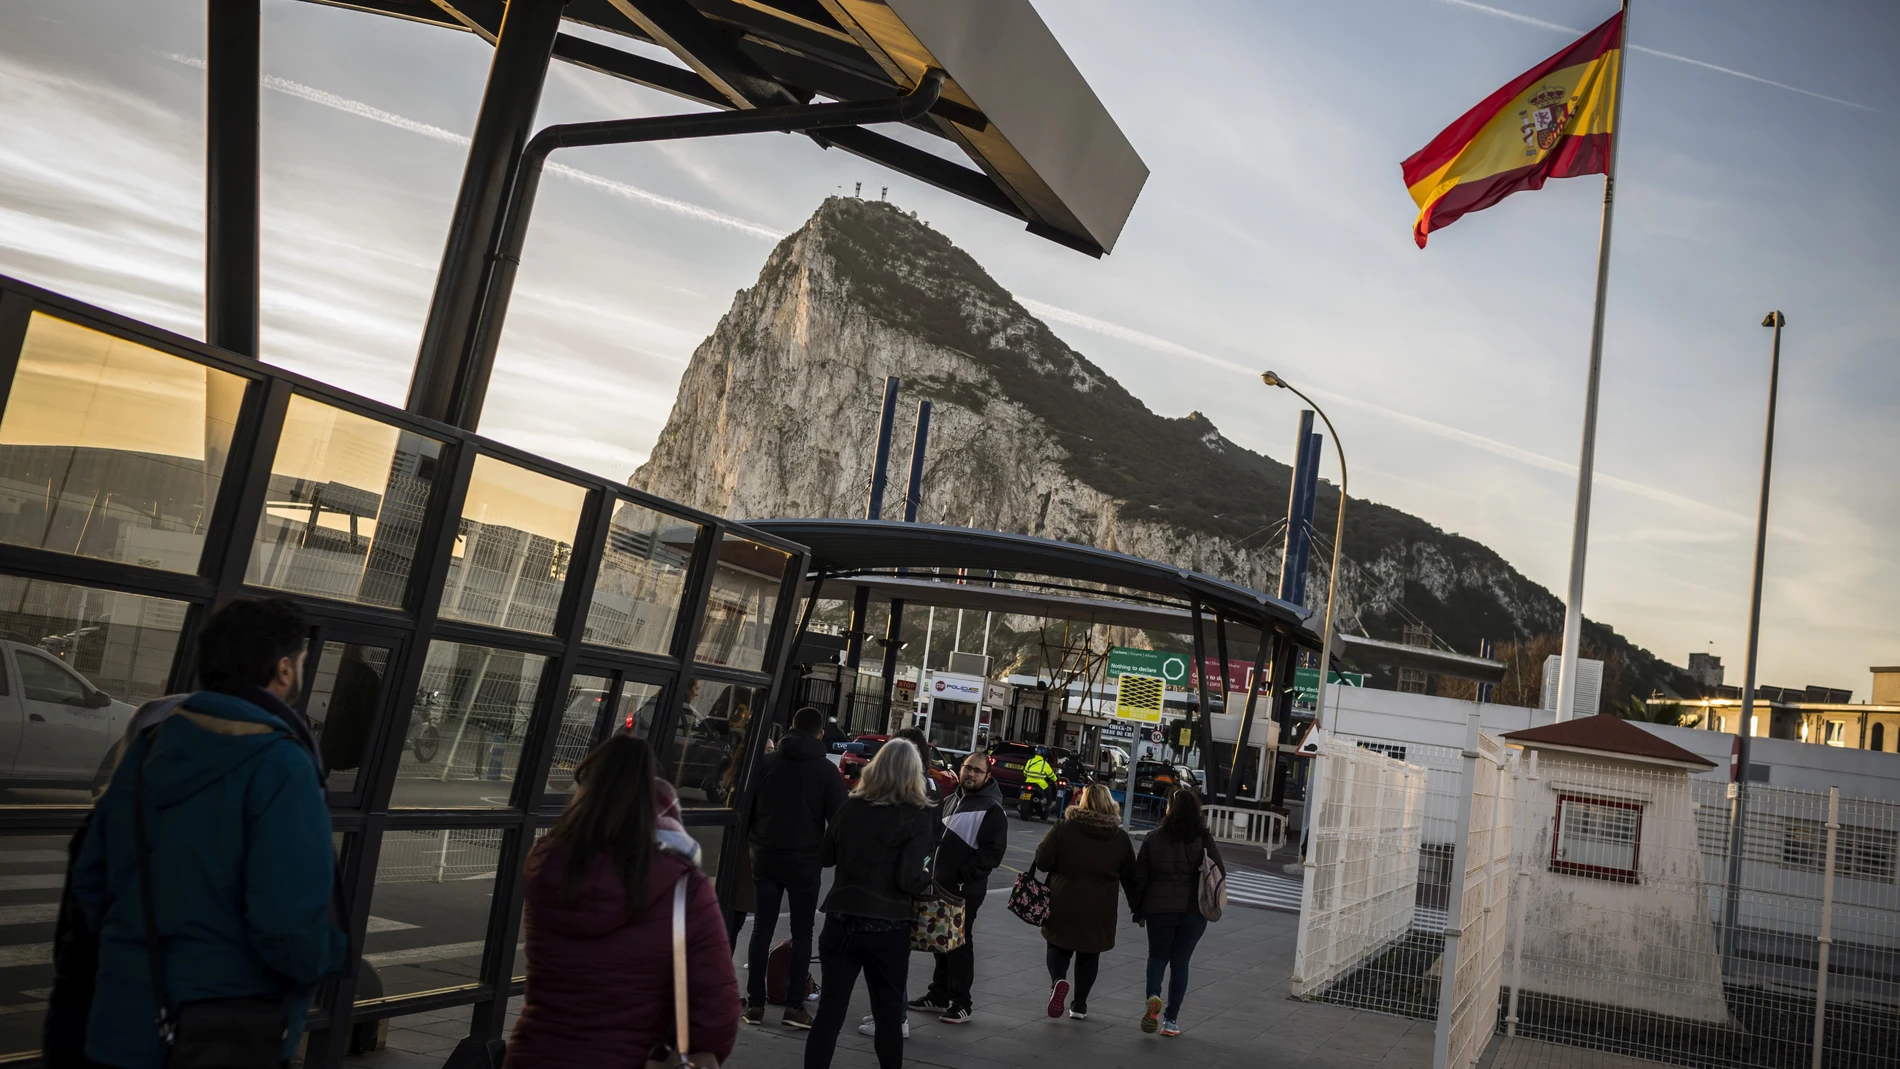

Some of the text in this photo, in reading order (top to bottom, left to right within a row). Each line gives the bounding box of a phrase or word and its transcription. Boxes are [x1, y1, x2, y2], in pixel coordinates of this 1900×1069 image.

[1110, 663, 1131, 671] Nothing
[898, 681, 915, 689] STOP
[1109, 724, 1132, 732] CHECK-IN
[1153, 733, 1161, 741] 10
